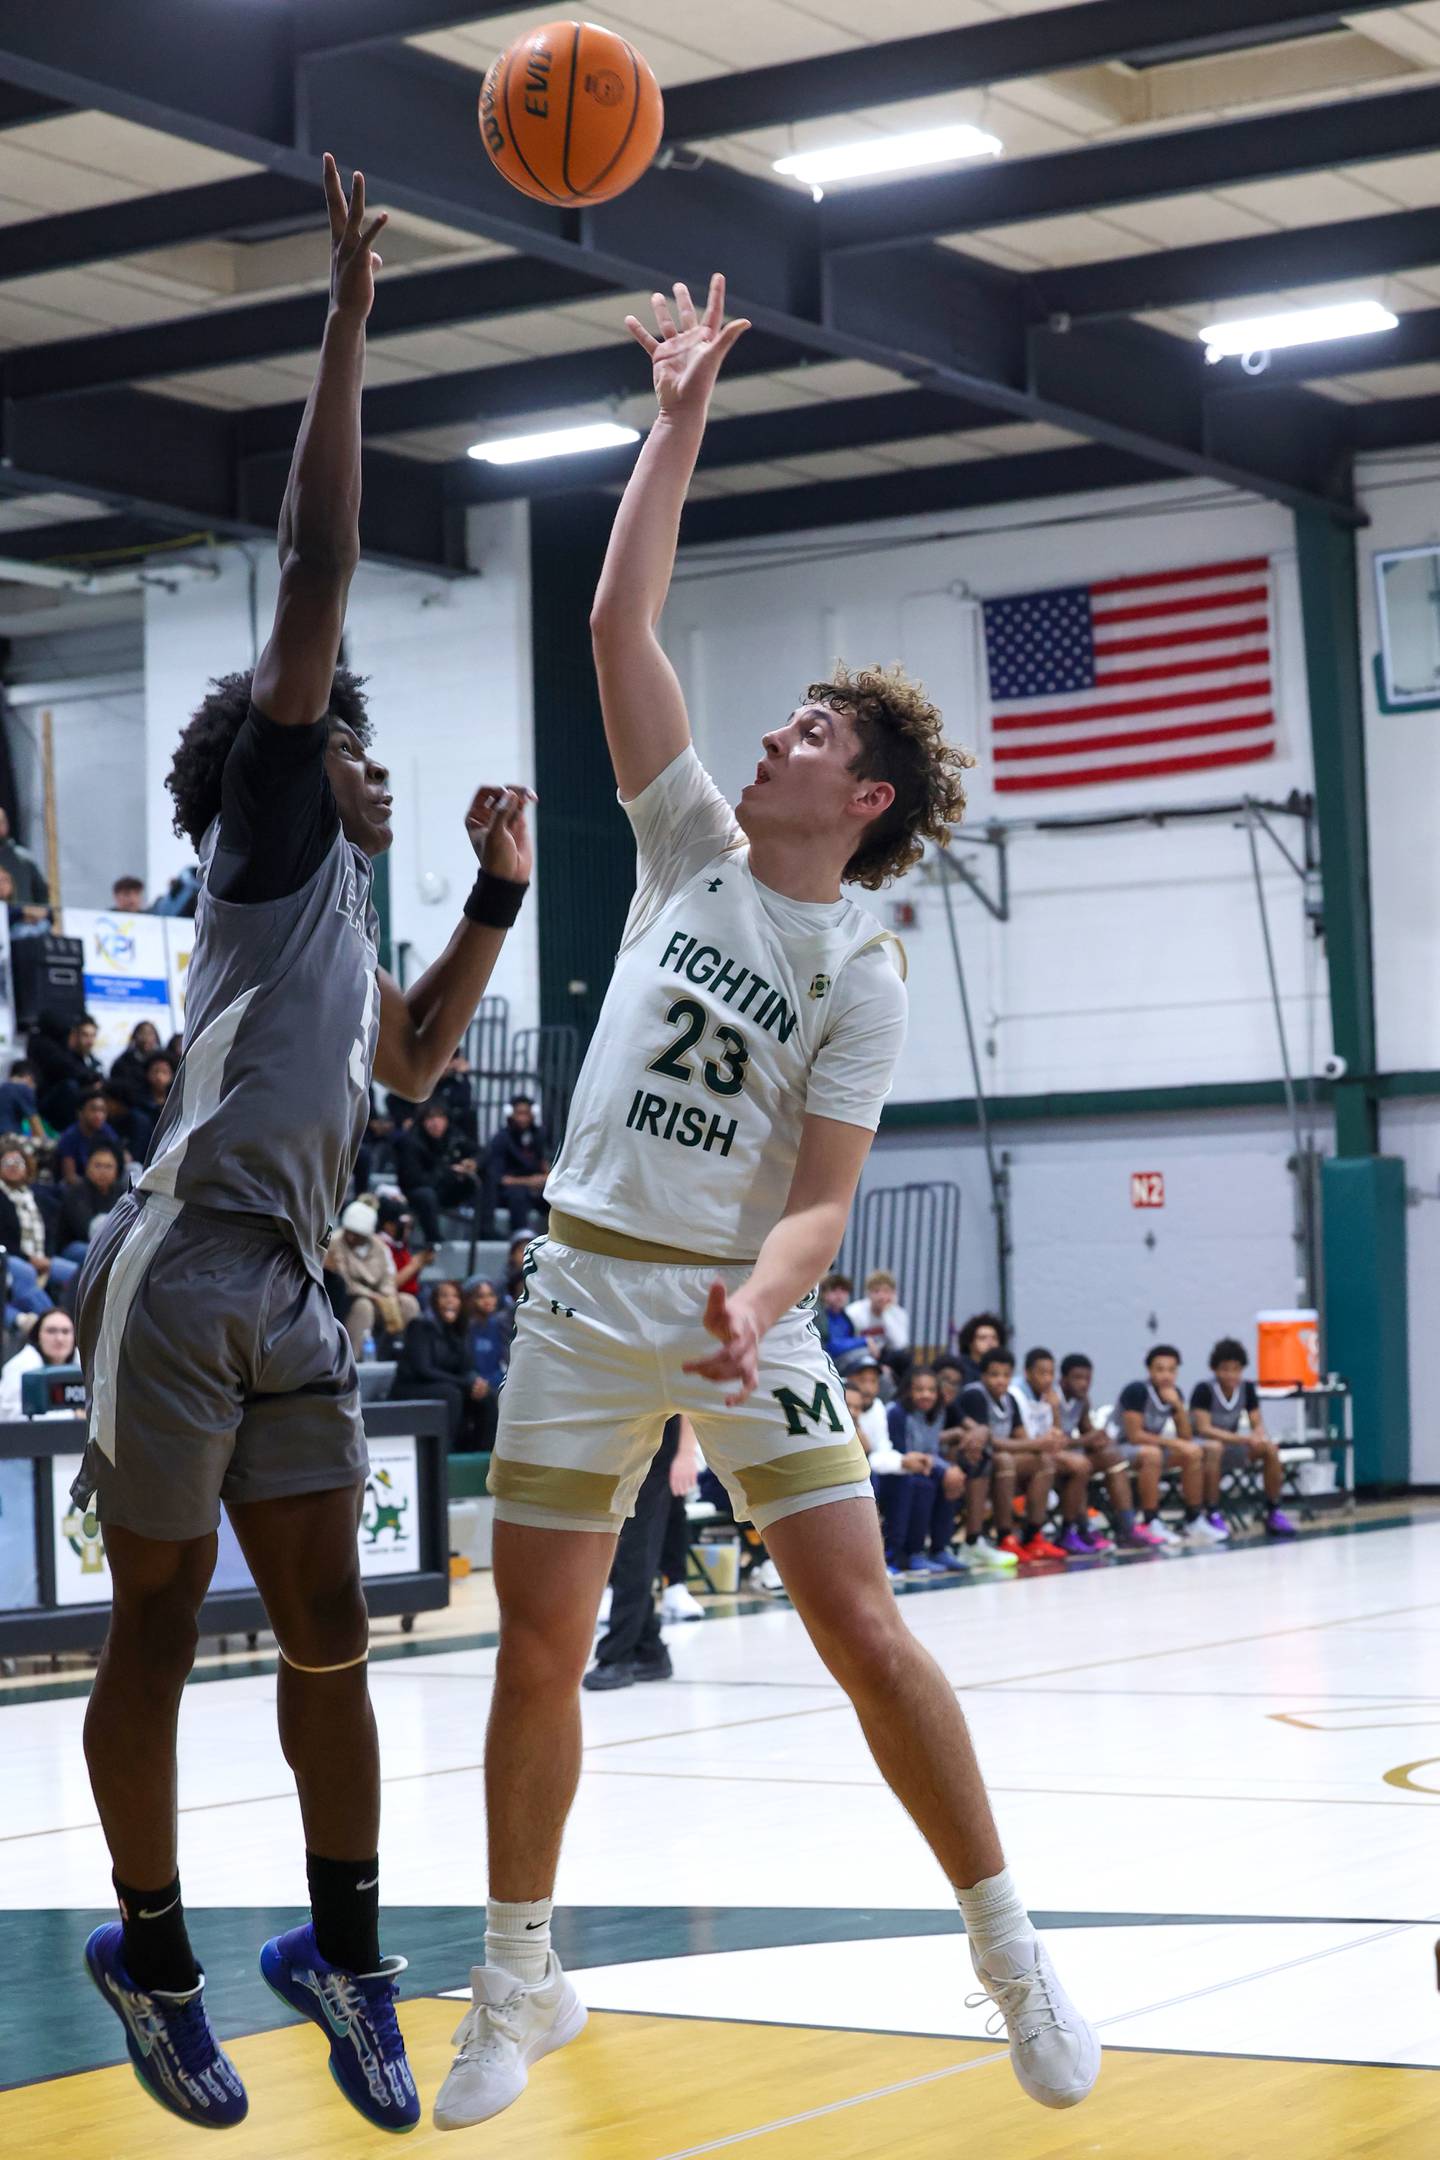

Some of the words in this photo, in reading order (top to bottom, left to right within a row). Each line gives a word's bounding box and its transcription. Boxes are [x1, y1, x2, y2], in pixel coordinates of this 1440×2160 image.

[645, 995, 751, 1098] 23
[626, 1089, 738, 1157] IRISH
[1132, 1176, 1164, 1204] N2
[772, 1382, 845, 1436] M
